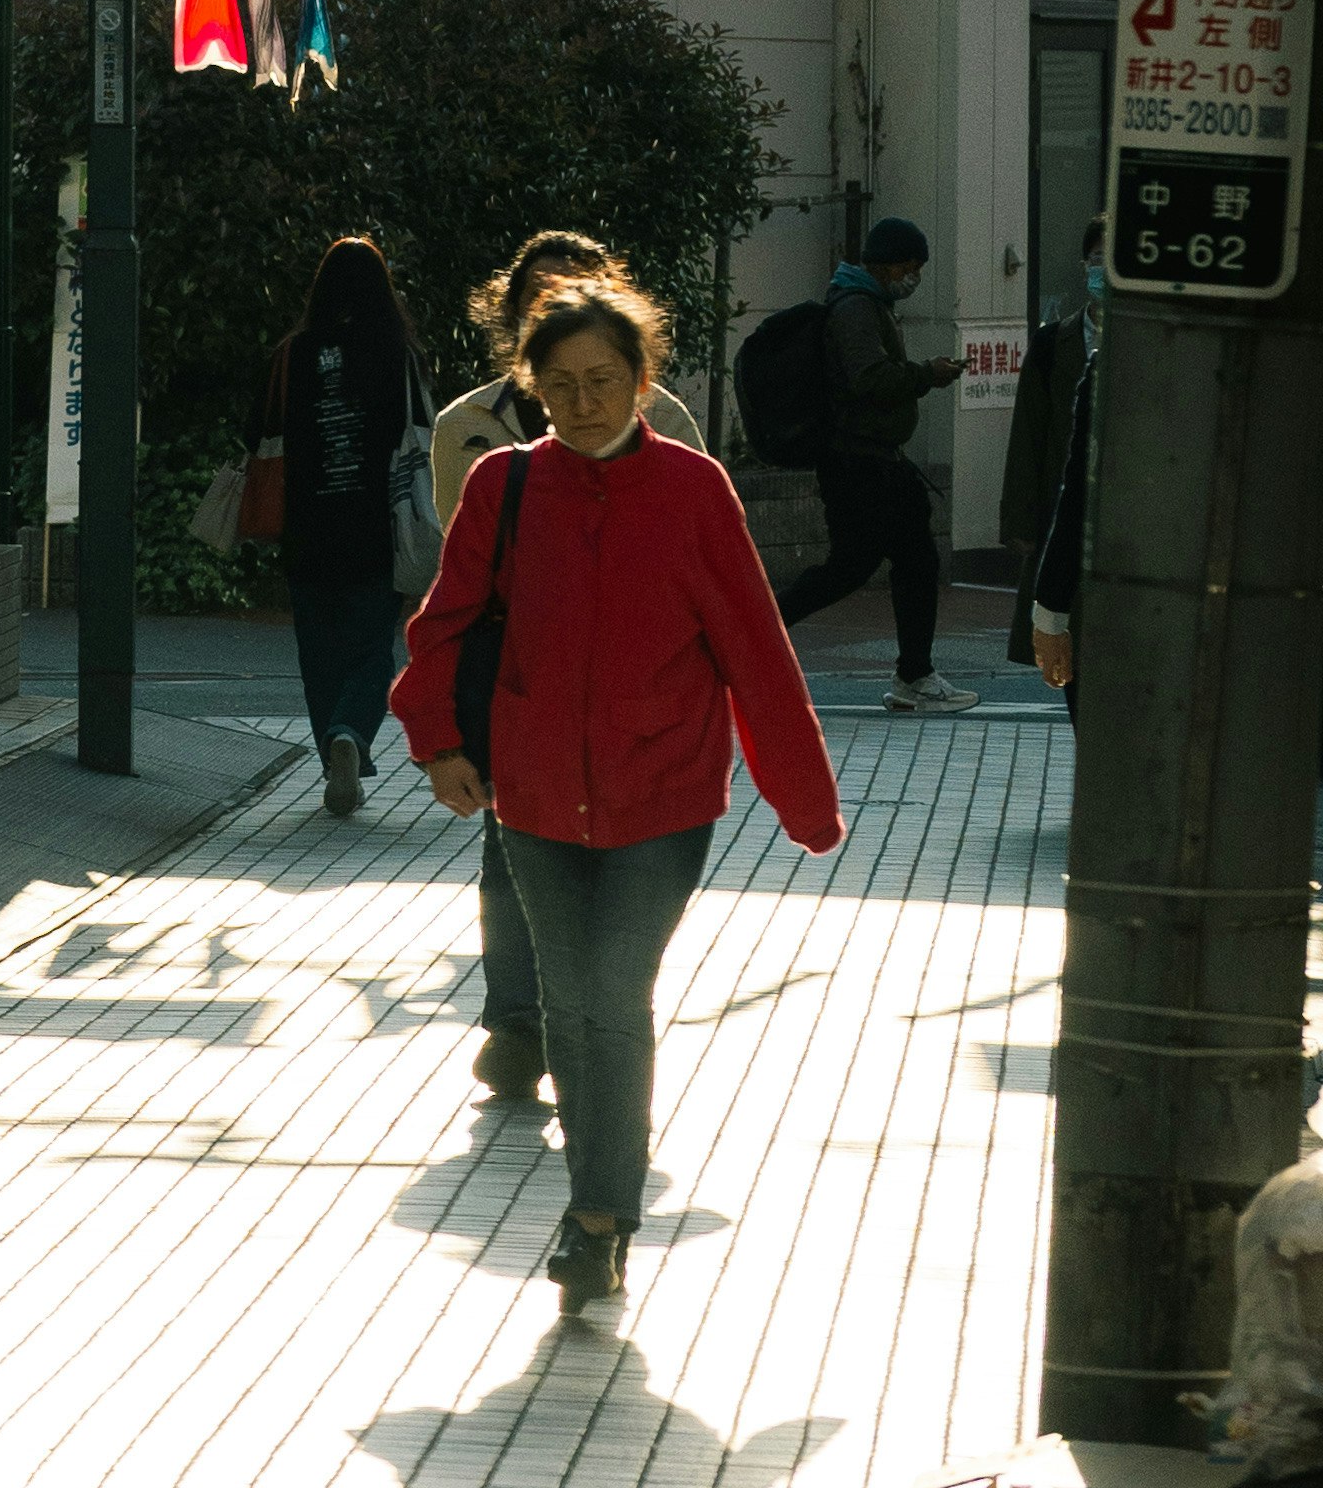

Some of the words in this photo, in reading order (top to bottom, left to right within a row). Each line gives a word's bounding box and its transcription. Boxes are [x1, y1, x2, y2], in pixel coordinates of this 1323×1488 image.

[1125, 56, 1293, 97] 新井2-10-3
[1123, 95, 1253, 137] 3385-2800
[1135, 229, 1248, 272] 5-62
